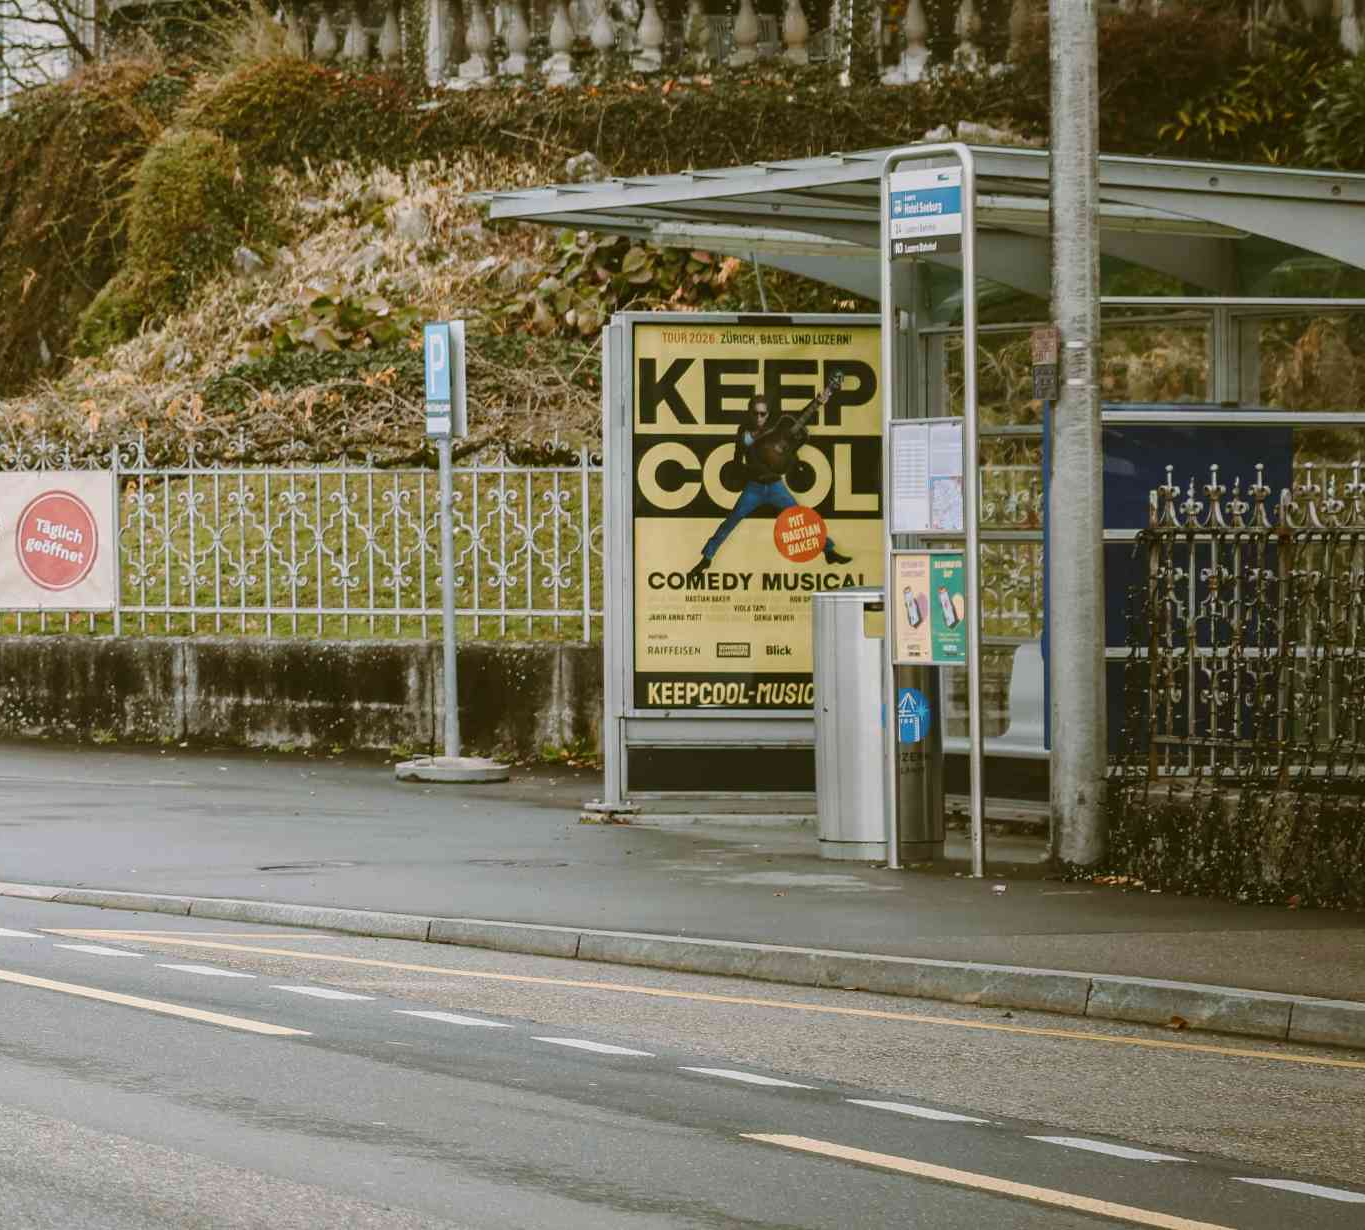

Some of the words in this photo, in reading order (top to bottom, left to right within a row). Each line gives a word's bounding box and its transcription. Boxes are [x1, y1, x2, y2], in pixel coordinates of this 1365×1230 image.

[661, 332, 687, 345] TOUR
[760, 333, 789, 345] BASEL
[792, 332, 810, 345] UND
[813, 333, 852, 345] LUZERN!
[429, 333, 445, 393] P
[639, 358, 877, 426] KEEP
[638, 441, 879, 511] COOL
[36, 517, 84, 544] Täglich
[788, 513, 805, 529] MIT
[781, 523, 822, 544] BASTIAN
[24, 537, 84, 566] geöffnet
[788, 537, 820, 556] BAKER
[647, 571, 754, 591] COMEDY
[647, 646, 701, 656] RAIFFEISEN
[766, 645, 792, 656] Blick
